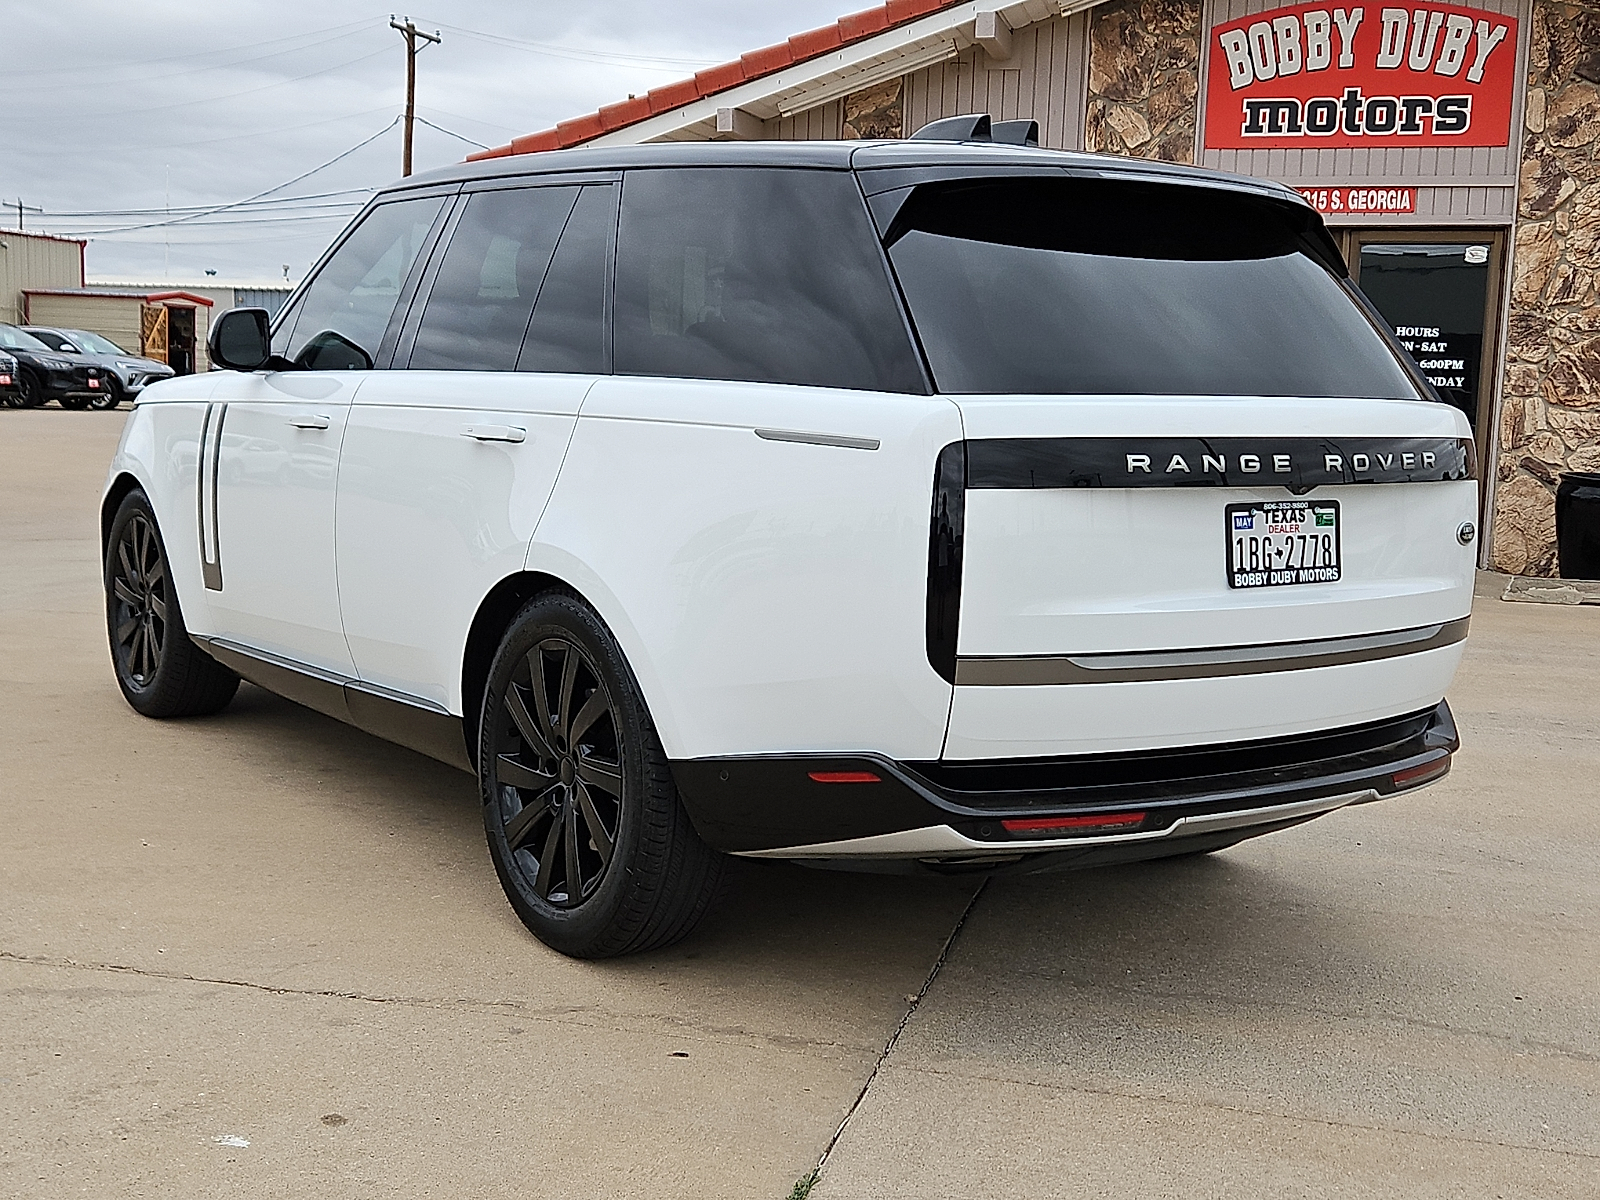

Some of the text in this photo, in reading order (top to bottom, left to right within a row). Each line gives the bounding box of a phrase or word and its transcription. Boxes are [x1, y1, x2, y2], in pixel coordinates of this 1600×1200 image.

[1220, 7, 1508, 90] BOBBY DUBY
[1241, 87, 1472, 137] motors
[1331, 189, 1344, 210] S.
[1348, 189, 1411, 210] GEORGIA
[1395, 326, 1440, 337] HOURS
[1126, 451, 1437, 474] RANGE ROVER
[1236, 517, 1252, 527] MAY
[1263, 509, 1305, 524] TEXAS
[1268, 524, 1300, 533] DEALER
[1234, 567, 1339, 587] BOBBY DUBY MOTORS
